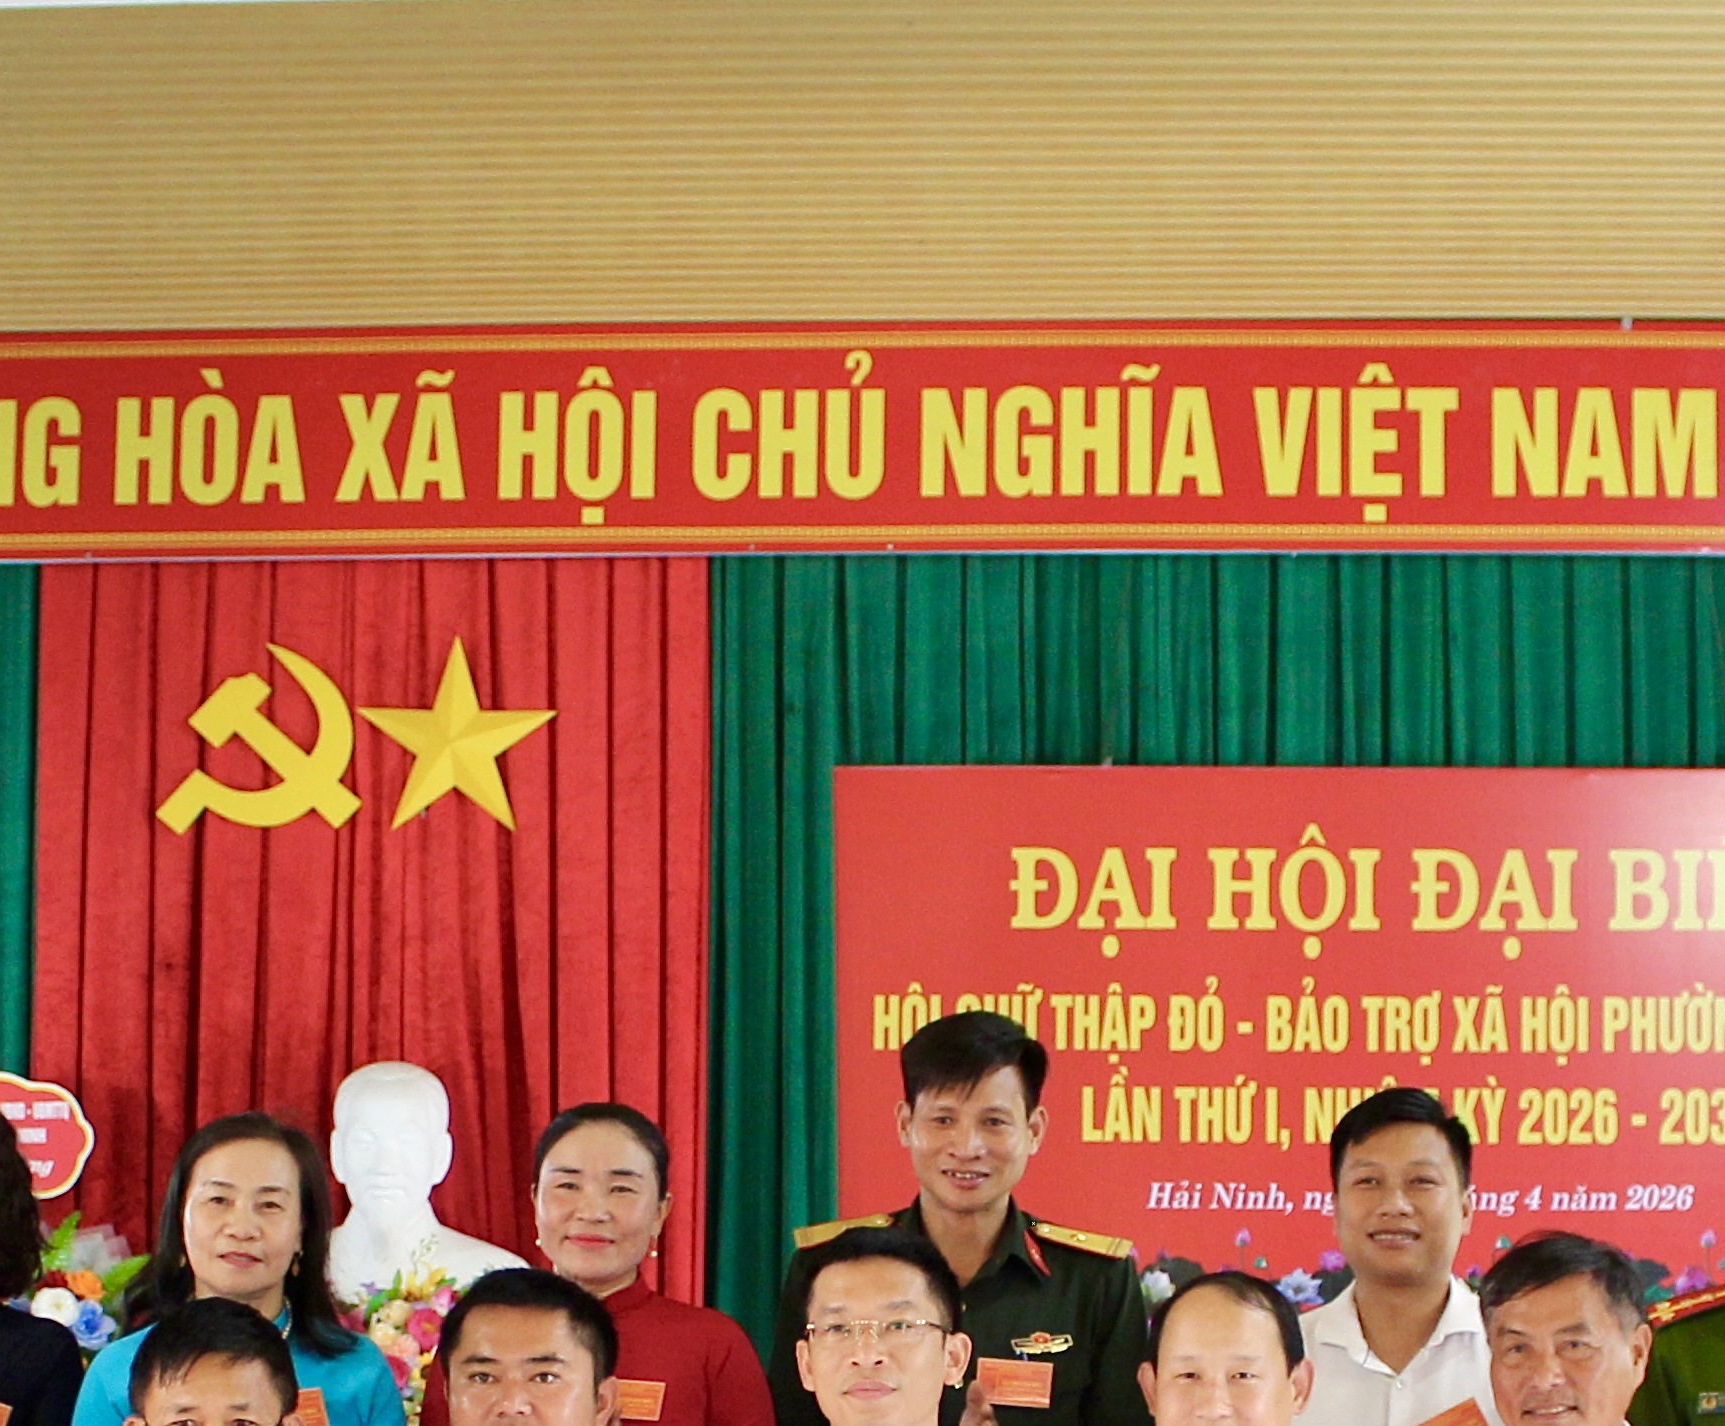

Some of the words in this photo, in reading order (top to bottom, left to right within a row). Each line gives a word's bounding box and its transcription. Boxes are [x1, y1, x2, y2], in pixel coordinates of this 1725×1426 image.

[114, 369, 305, 505] HÒA
[335, 370, 465, 502] XÃ
[498, 367, 656, 524] HỘI
[693, 350, 885, 500] CHỦ
[921, 364, 1223, 498] NGHĨA
[1253, 363, 1459, 523] VIỆT
[1492, 388, 1717, 498] NAM
[1010, 847, 1177, 957] ĐẠI
[1207, 823, 1380, 959] HỘI
[1411, 849, 1578, 959] ĐẠI
[1050, 983, 1156, 1064] THẬP
[1168, 976, 1223, 1052] ĐỎ
[1266, 976, 1348, 1053] BẢO
[1361, 990, 1441, 1065] TRỢ
[1453, 985, 1508, 1053] XÃ
[1521, 984, 1589, 1066] HỘI
[1082, 1066, 1161, 1142] LẦN
[1174, 1075, 1257, 1143] THỨ
[1266, 1087, 1290, 1150] I,
[1453, 1075, 1506, 1144] KỲ
[1518, 1088, 1618, 1144] 2026
[1147, 1181, 1202, 1209] Hải
[1210, 1181, 1294, 1216] Ninh,
[1304, 1191, 1335, 1215] ng
[1524, 1187, 1541, 1211] 4
[1551, 1187, 1618, 1211] năm
[1625, 1184, 1695, 1211] 2026
